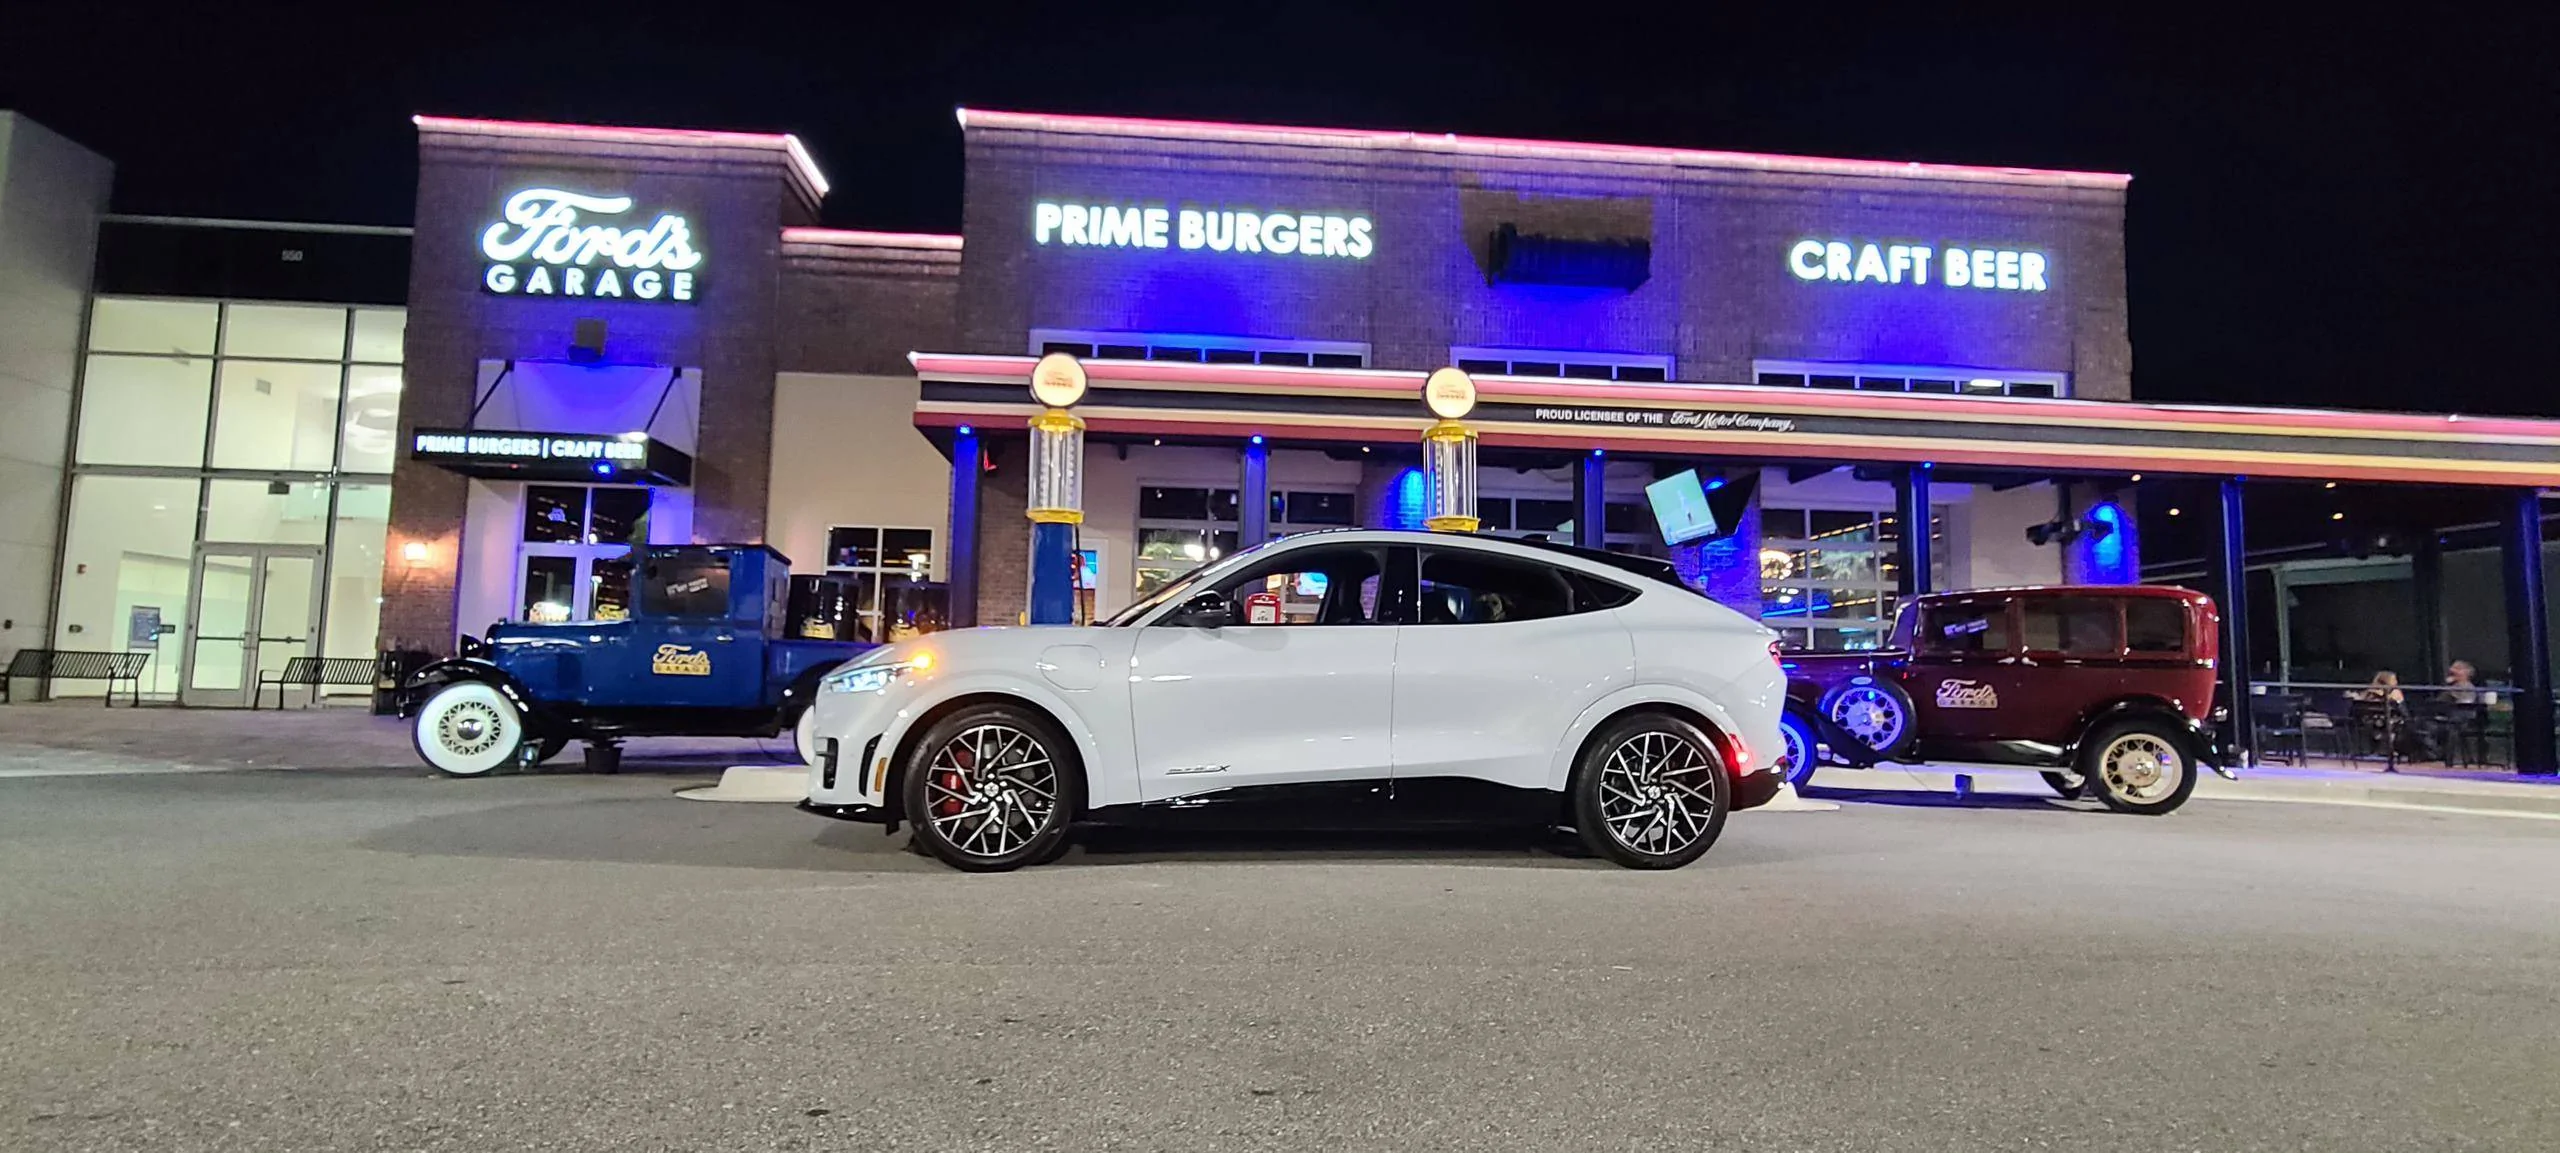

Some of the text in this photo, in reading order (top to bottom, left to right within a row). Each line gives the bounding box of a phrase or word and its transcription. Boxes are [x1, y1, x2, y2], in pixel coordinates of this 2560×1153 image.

[482, 188, 702, 270] Ford's
[1035, 203, 1373, 258] PRIME BURGERS
[486, 264, 692, 300] GARAGE
[1790, 239, 2047, 292] CRAFT BEER
[1535, 408, 1573, 421] PROUD
[1574, 410, 1625, 423] LICENSEE
[1625, 412, 1641, 424] OF
[1642, 412, 1664, 424] THE
[1670, 411, 1702, 425] Ford
[416, 435, 644, 460] PRIME BURGERS CRAFT BEER
